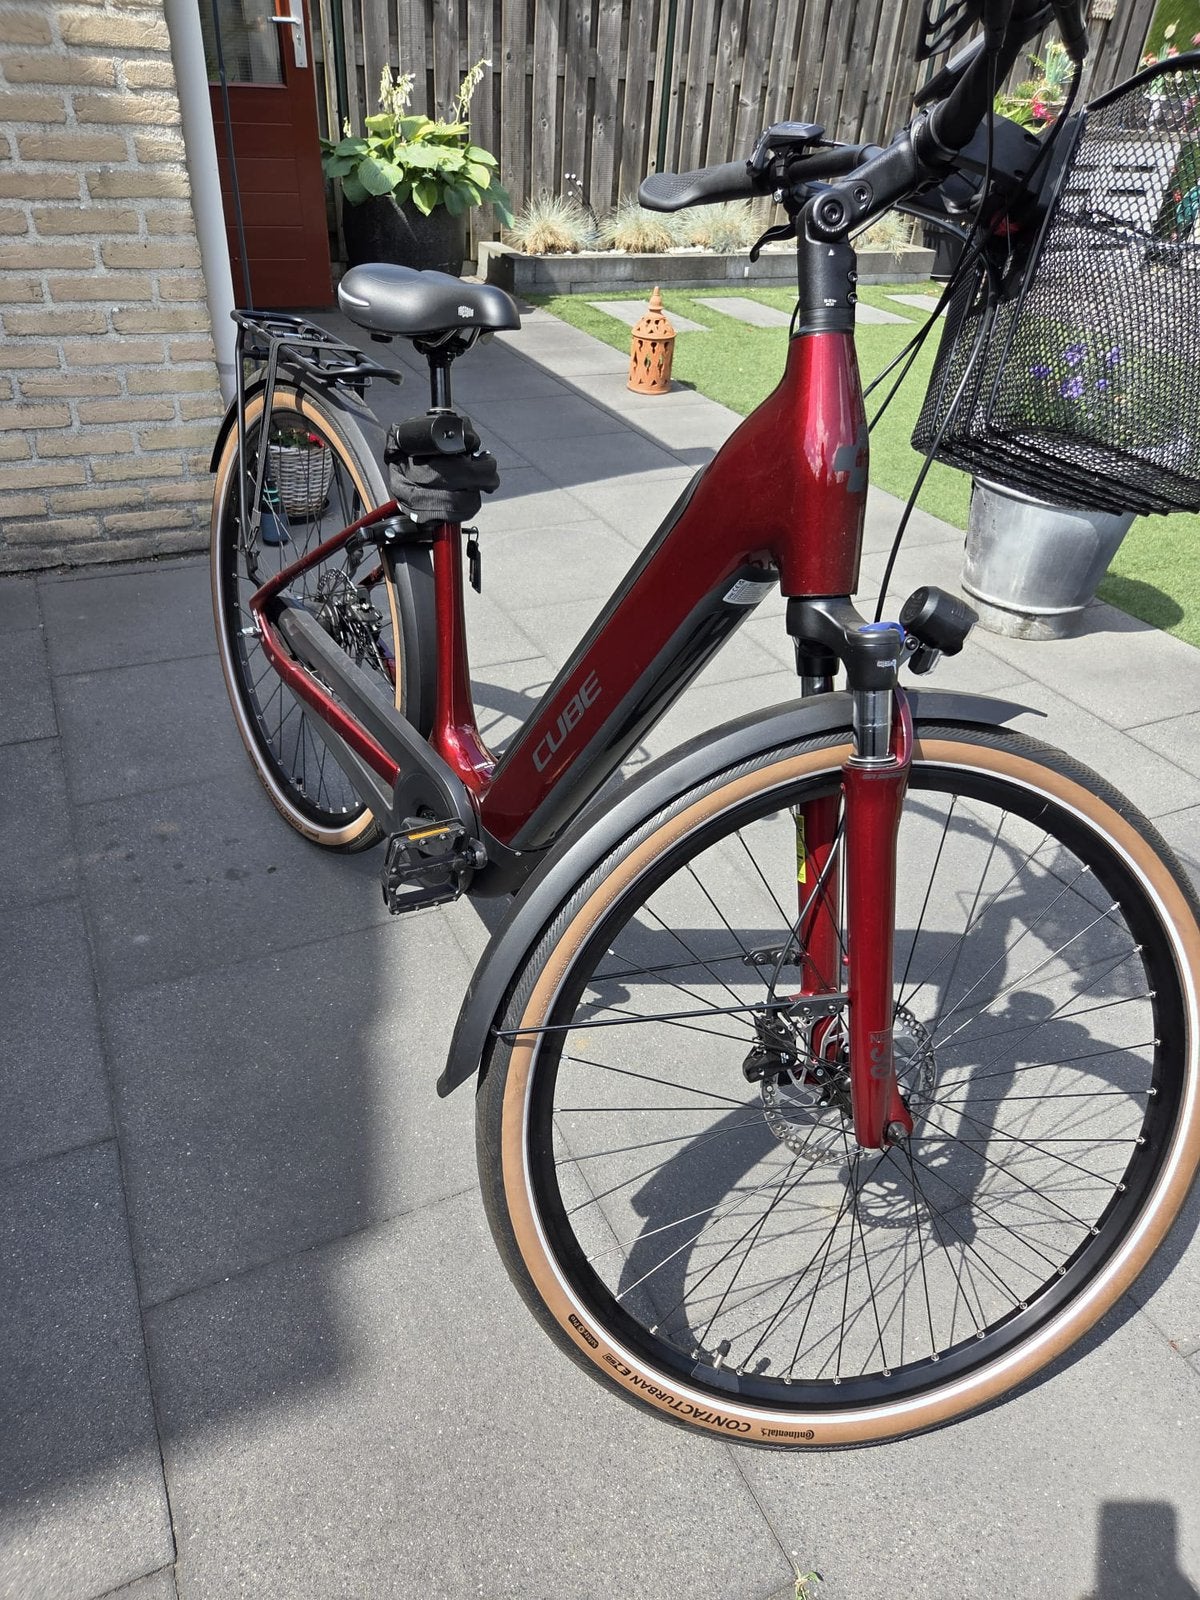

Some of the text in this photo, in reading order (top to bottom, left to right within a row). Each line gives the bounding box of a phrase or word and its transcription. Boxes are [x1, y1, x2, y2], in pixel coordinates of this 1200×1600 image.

[532, 669, 603, 773] CUBE
[570, 1314, 580, 1327] Pro
[768, 1428, 815, 1440] Continental
